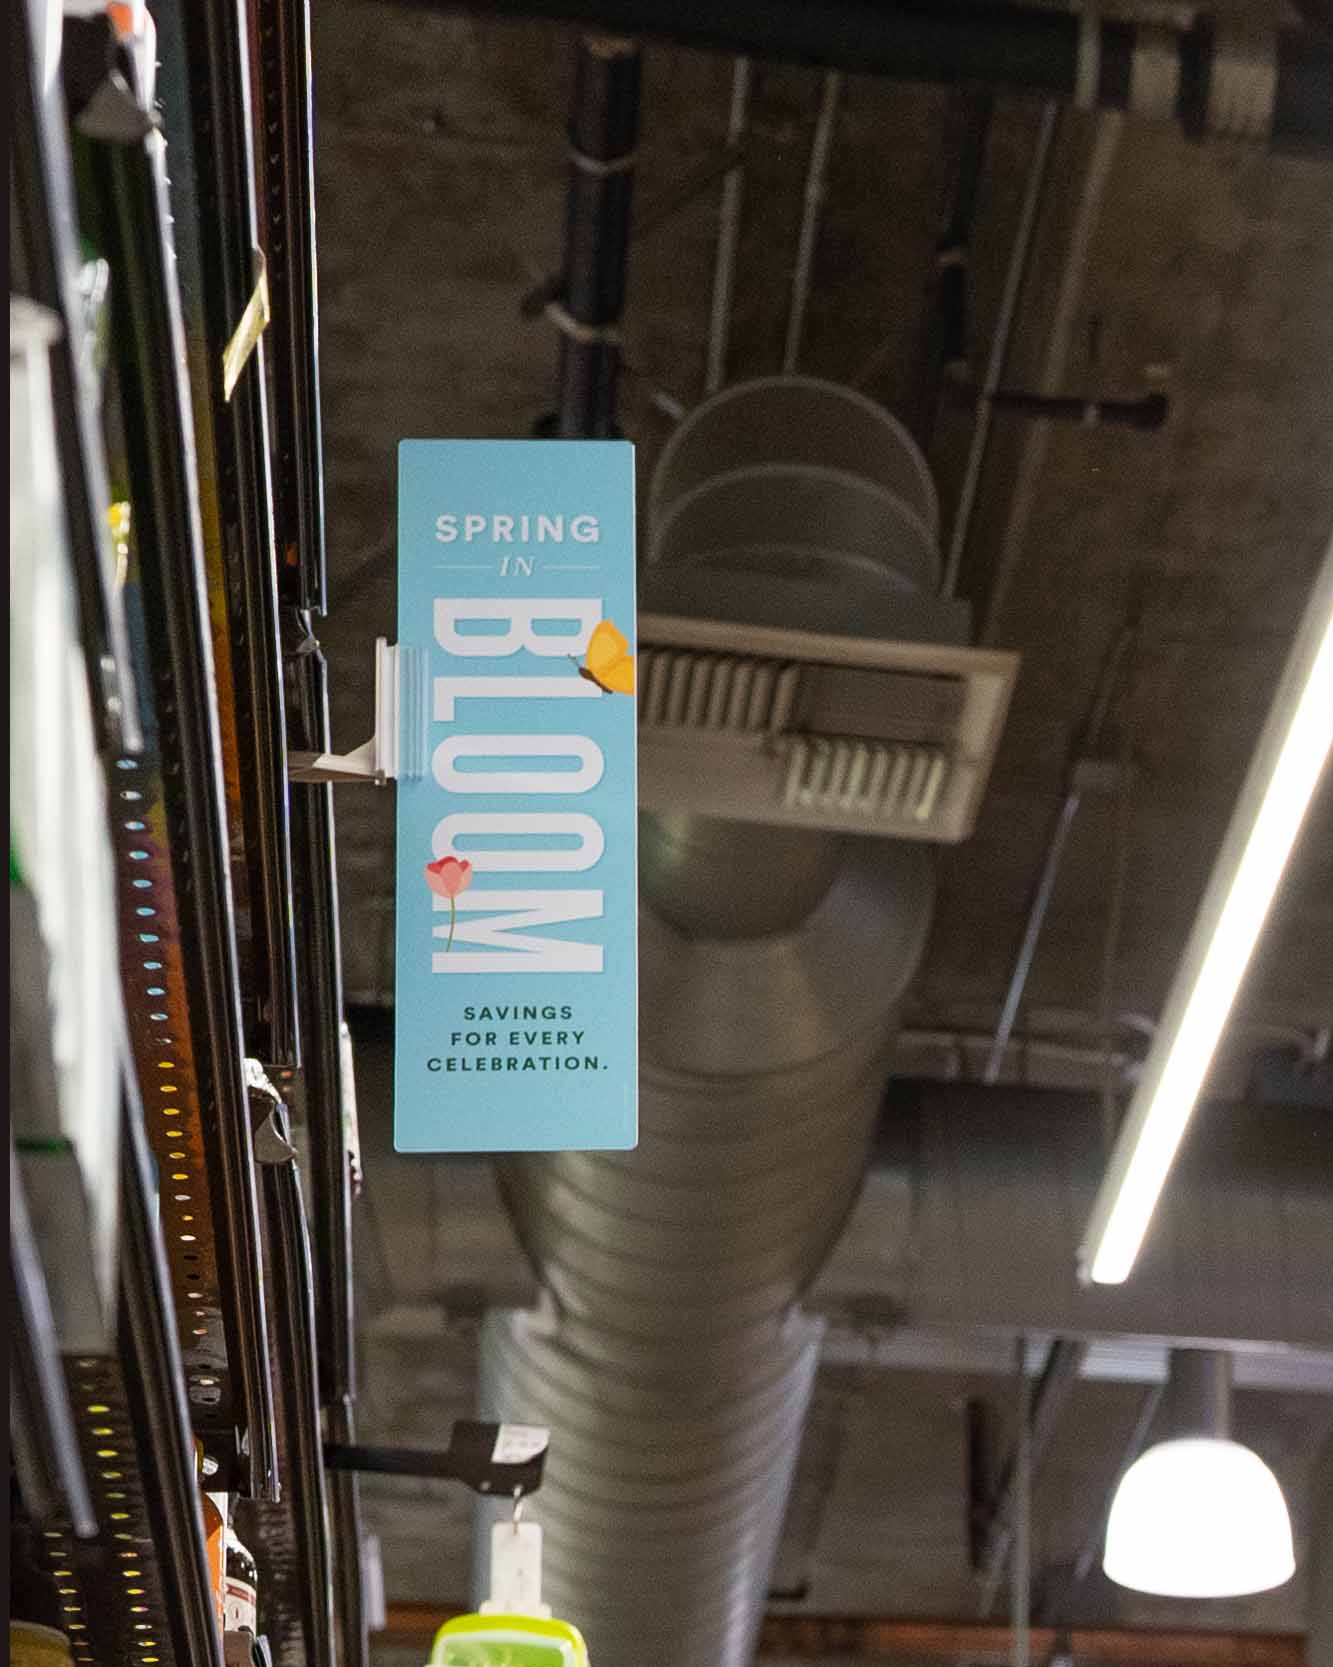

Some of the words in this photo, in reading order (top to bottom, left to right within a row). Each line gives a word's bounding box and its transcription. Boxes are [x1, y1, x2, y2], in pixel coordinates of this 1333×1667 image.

[435, 513, 602, 544] SPRING
[500, 555, 537, 577] IN
[430, 597, 605, 974] BLOOM
[462, 1005, 574, 1022] SAVINGS
[450, 1030, 499, 1047] FOR
[509, 1030, 587, 1047] EVERY
[425, 1056, 609, 1073] CELEBRATION.
